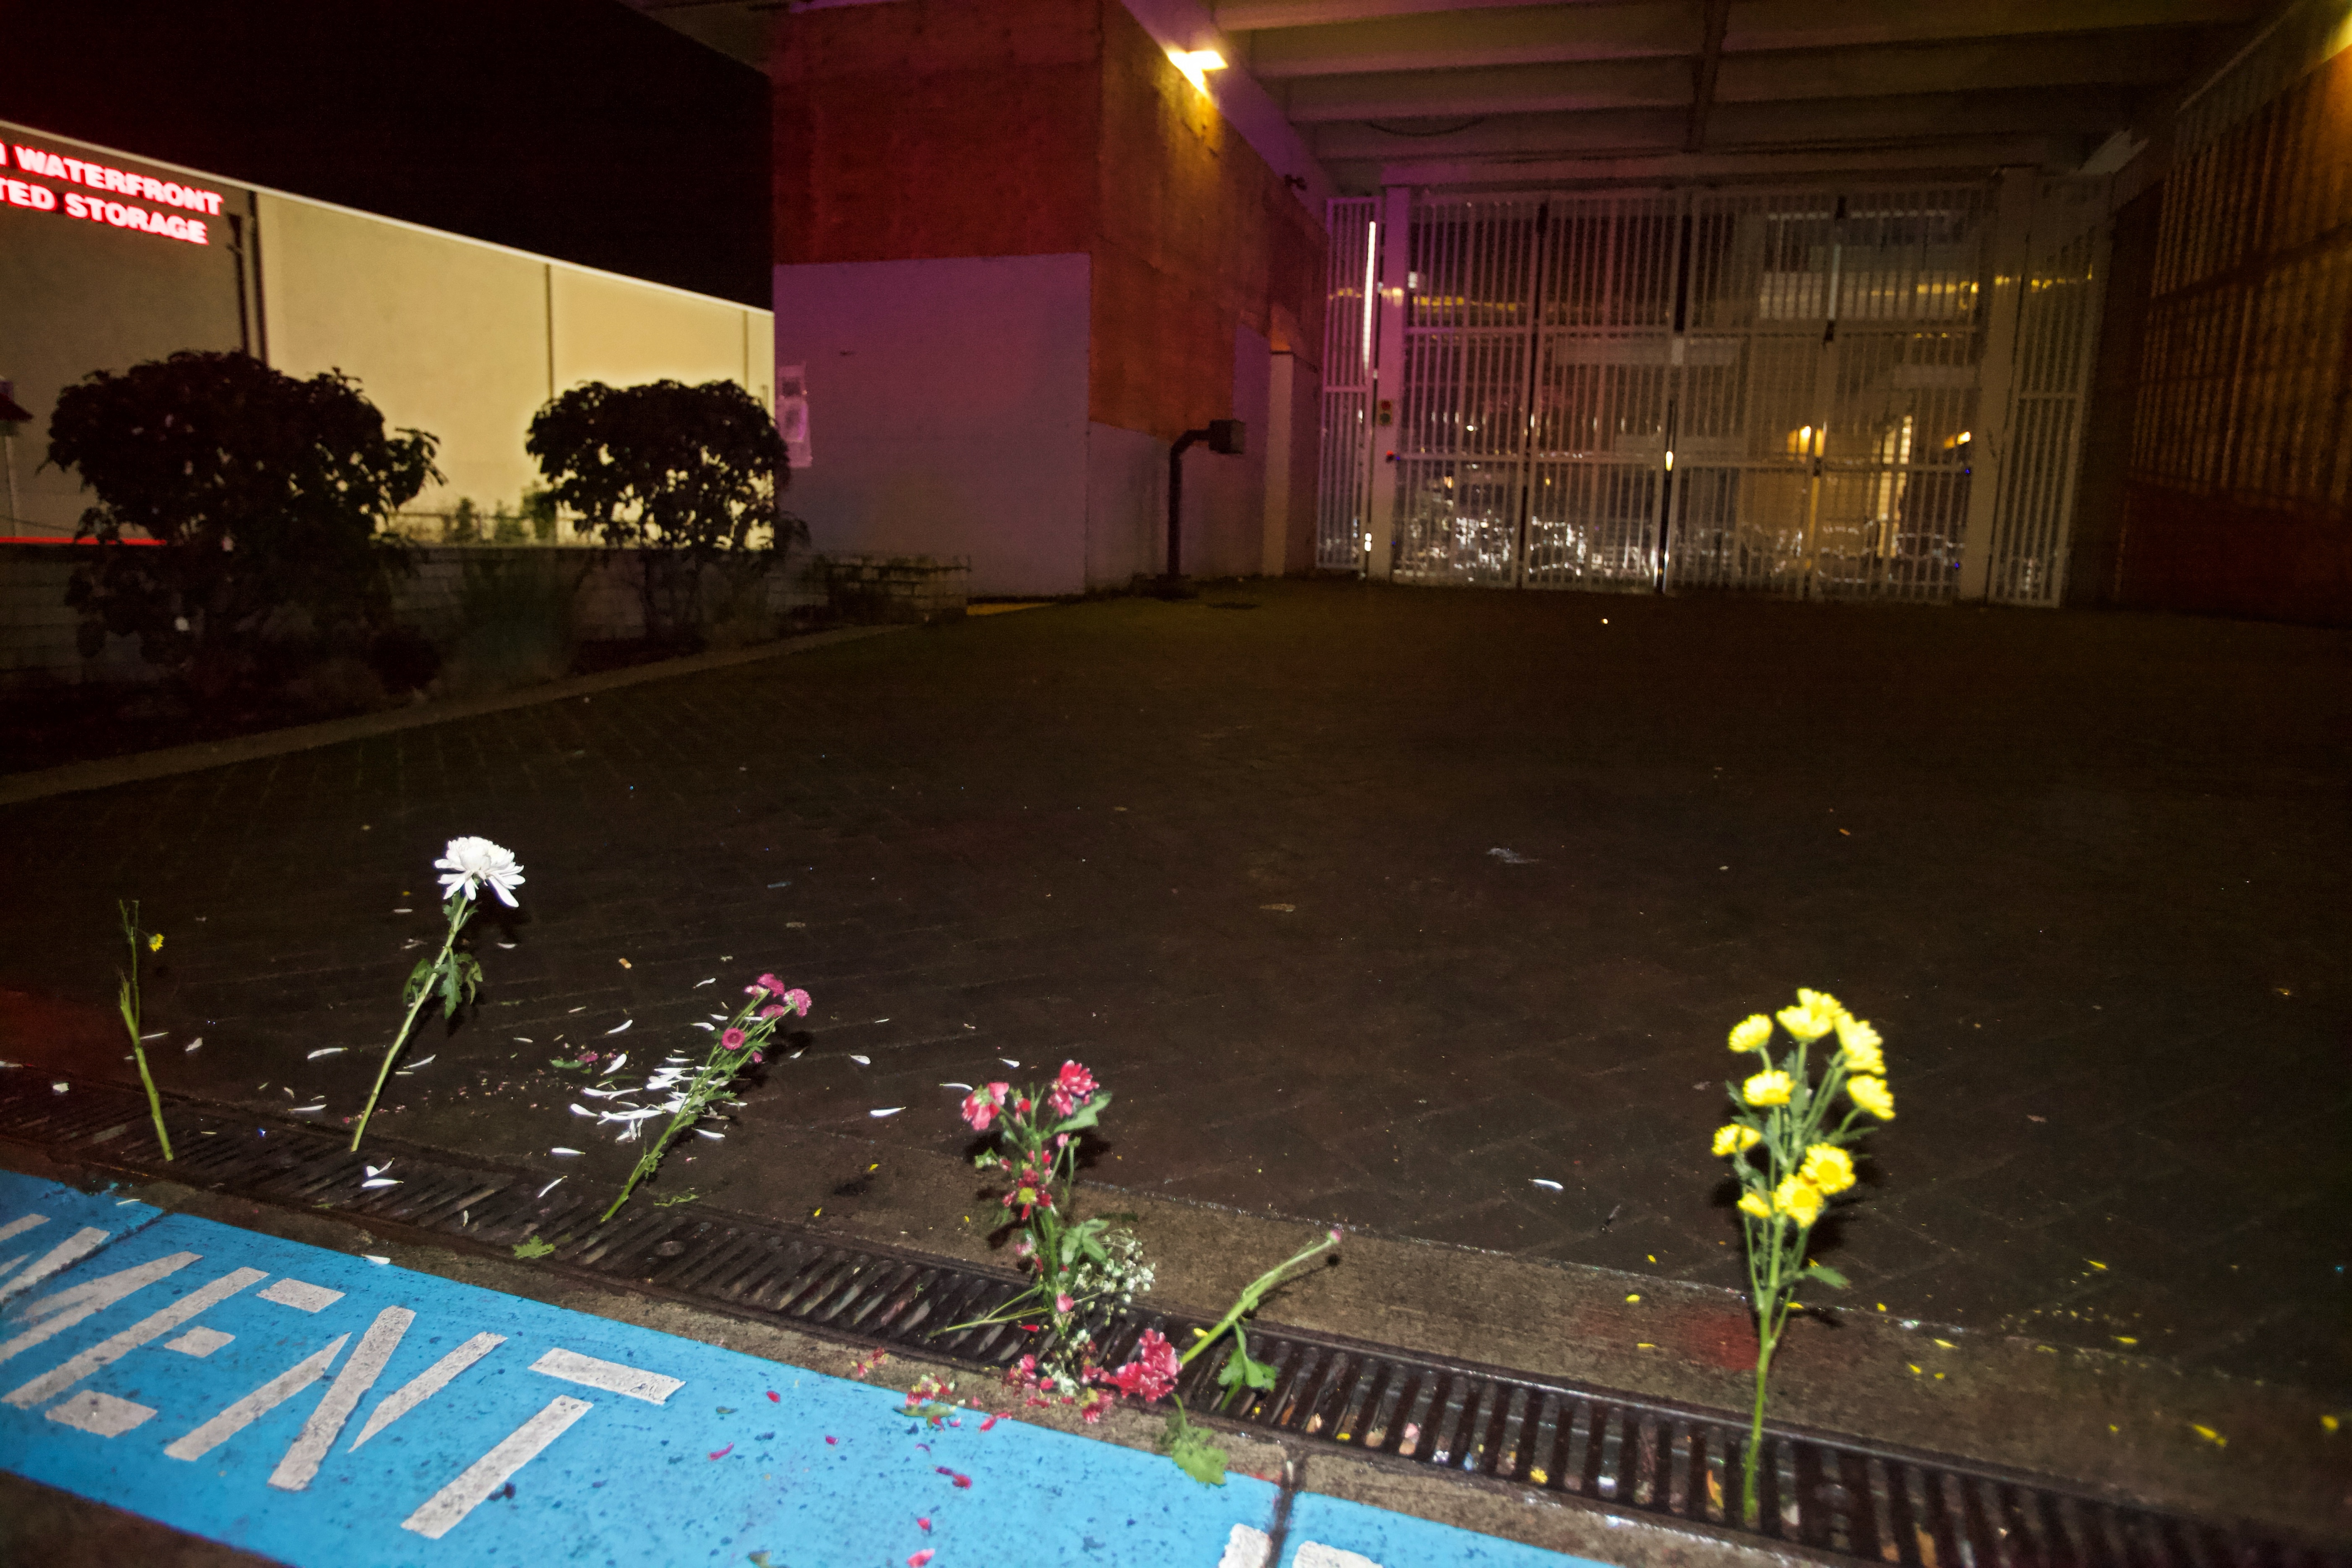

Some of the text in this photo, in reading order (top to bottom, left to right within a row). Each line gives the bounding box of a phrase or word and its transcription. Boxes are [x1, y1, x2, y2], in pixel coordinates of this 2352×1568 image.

[14, 145, 223, 215] WATERFRONT
[64, 192, 209, 244] STORAGE
[0, 1214, 686, 1539] MENT
